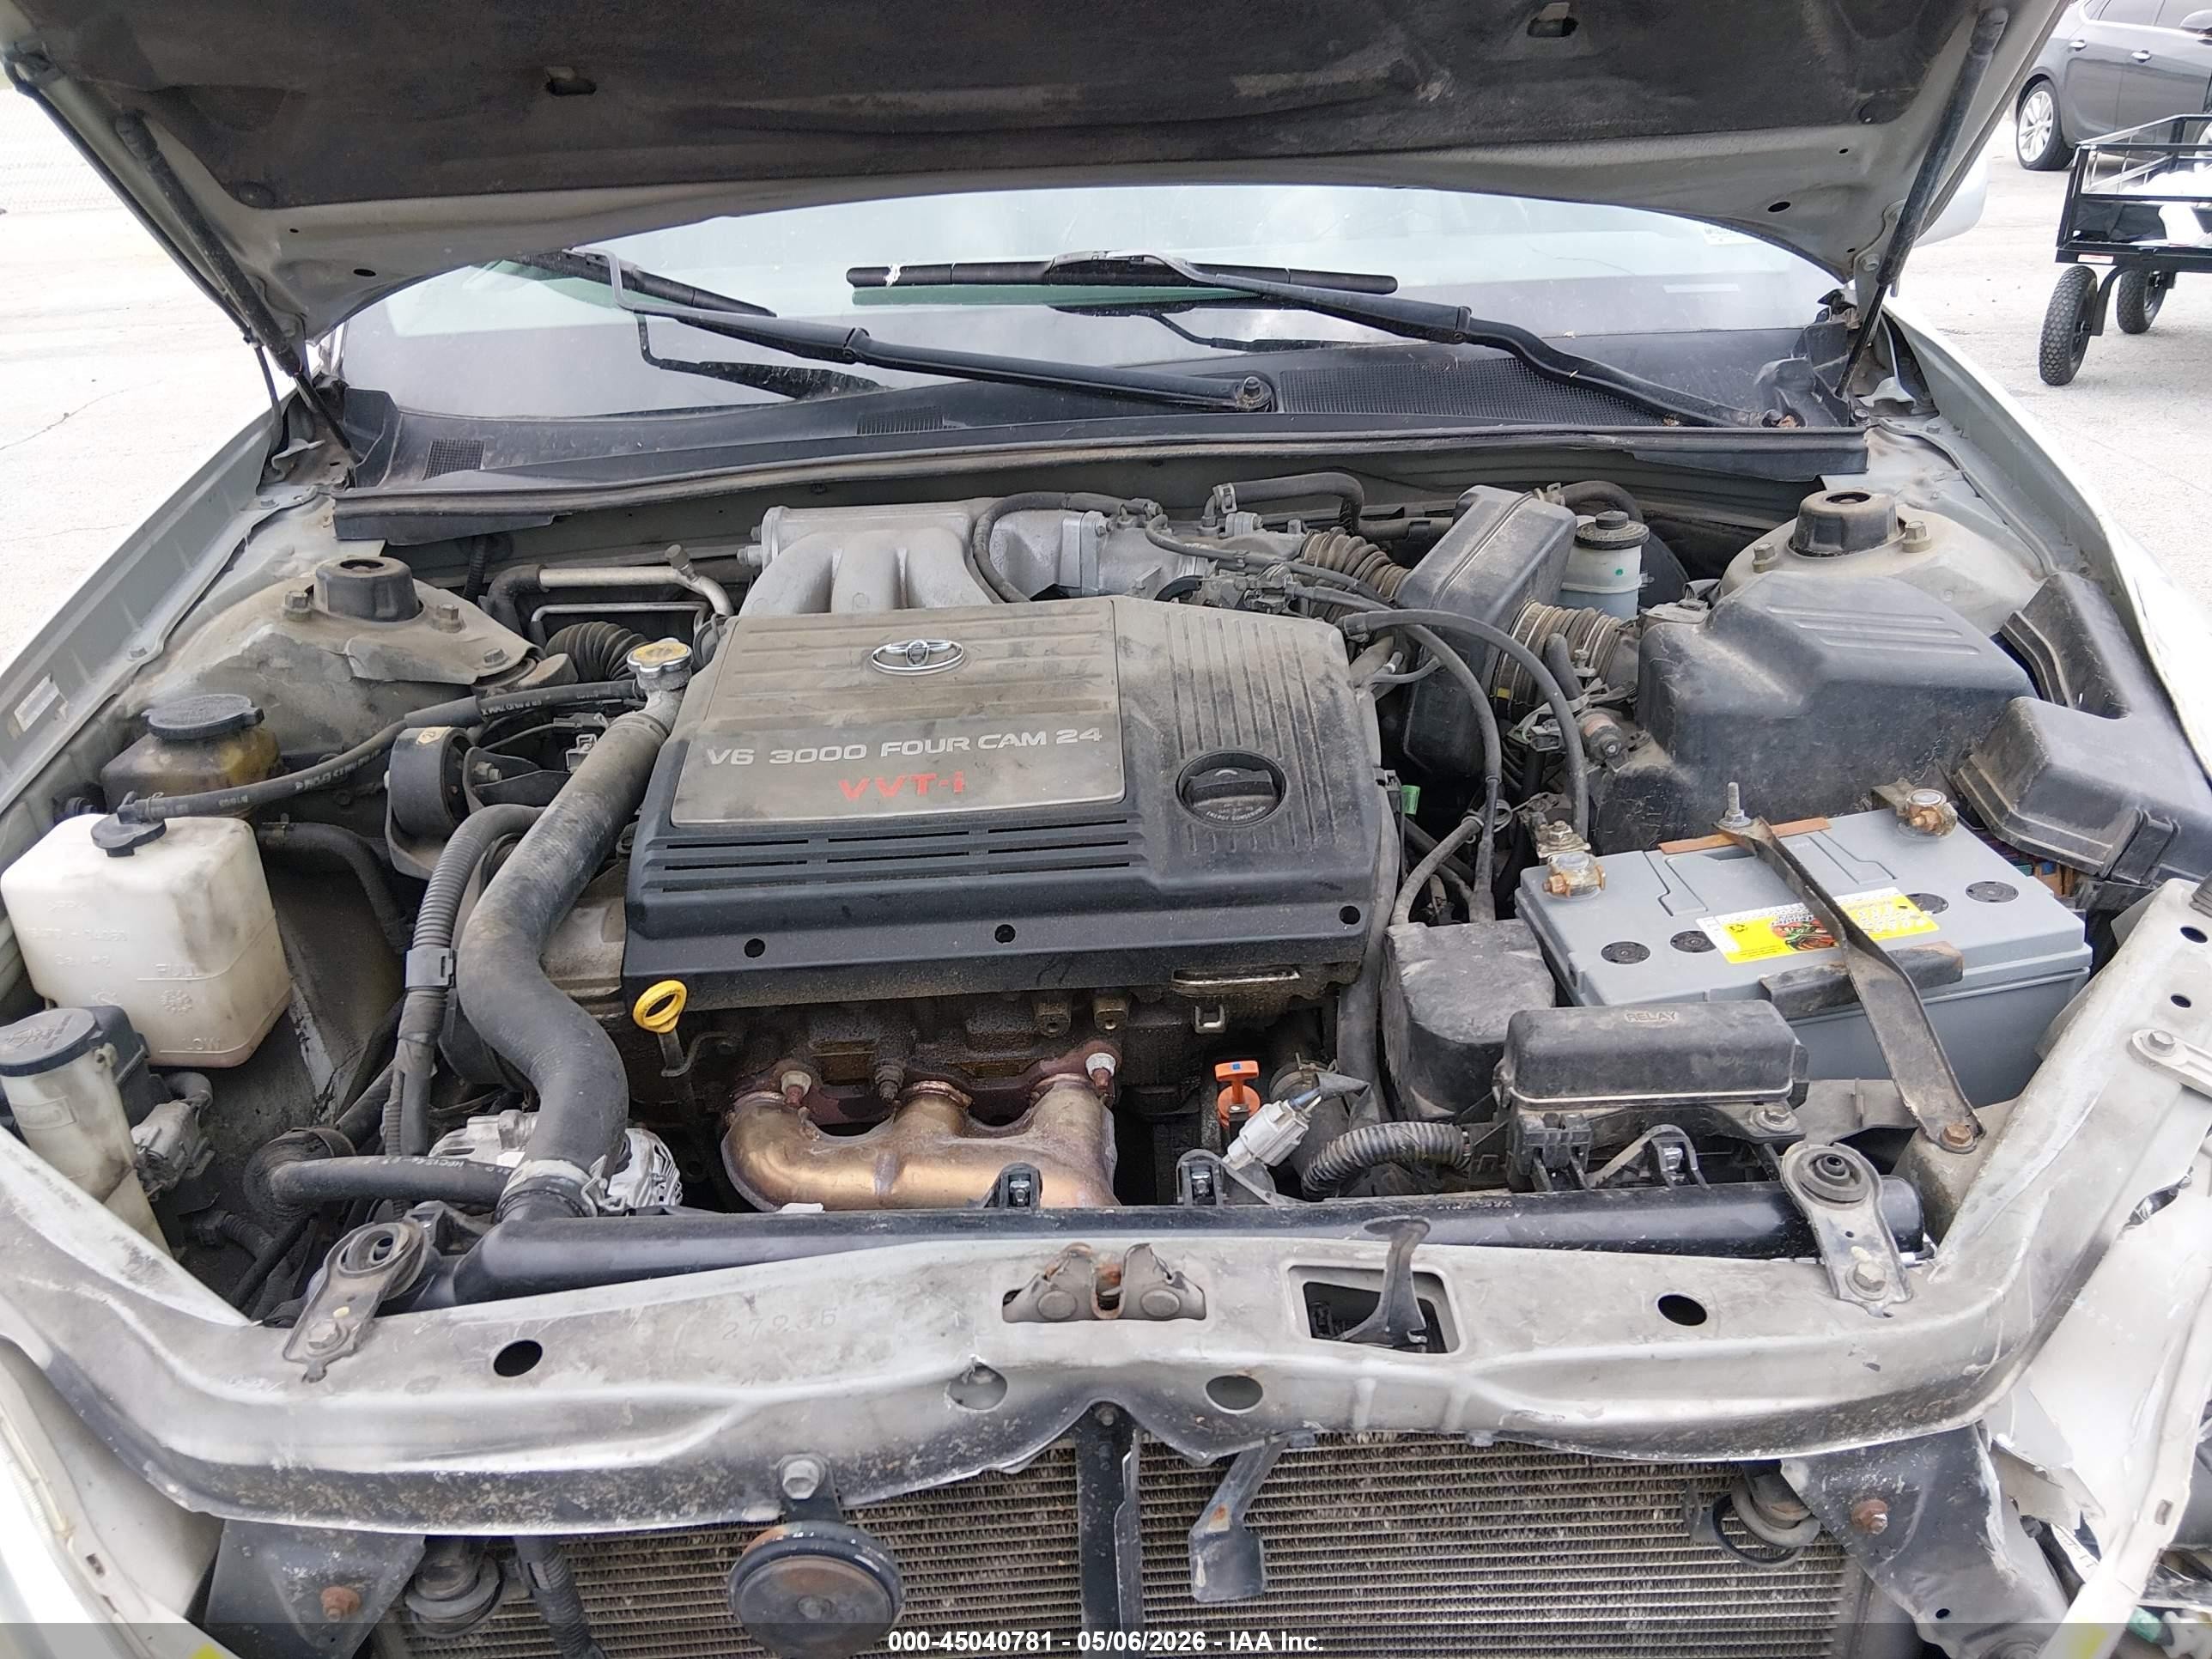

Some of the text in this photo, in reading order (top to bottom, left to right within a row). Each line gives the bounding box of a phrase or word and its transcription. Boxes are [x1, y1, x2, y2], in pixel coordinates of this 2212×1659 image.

[707, 727, 1103, 765] V6 3000 FOUR CAM 24
[838, 770, 965, 802] VVT-i
[1626, 1012, 1676, 1023] RELAY
